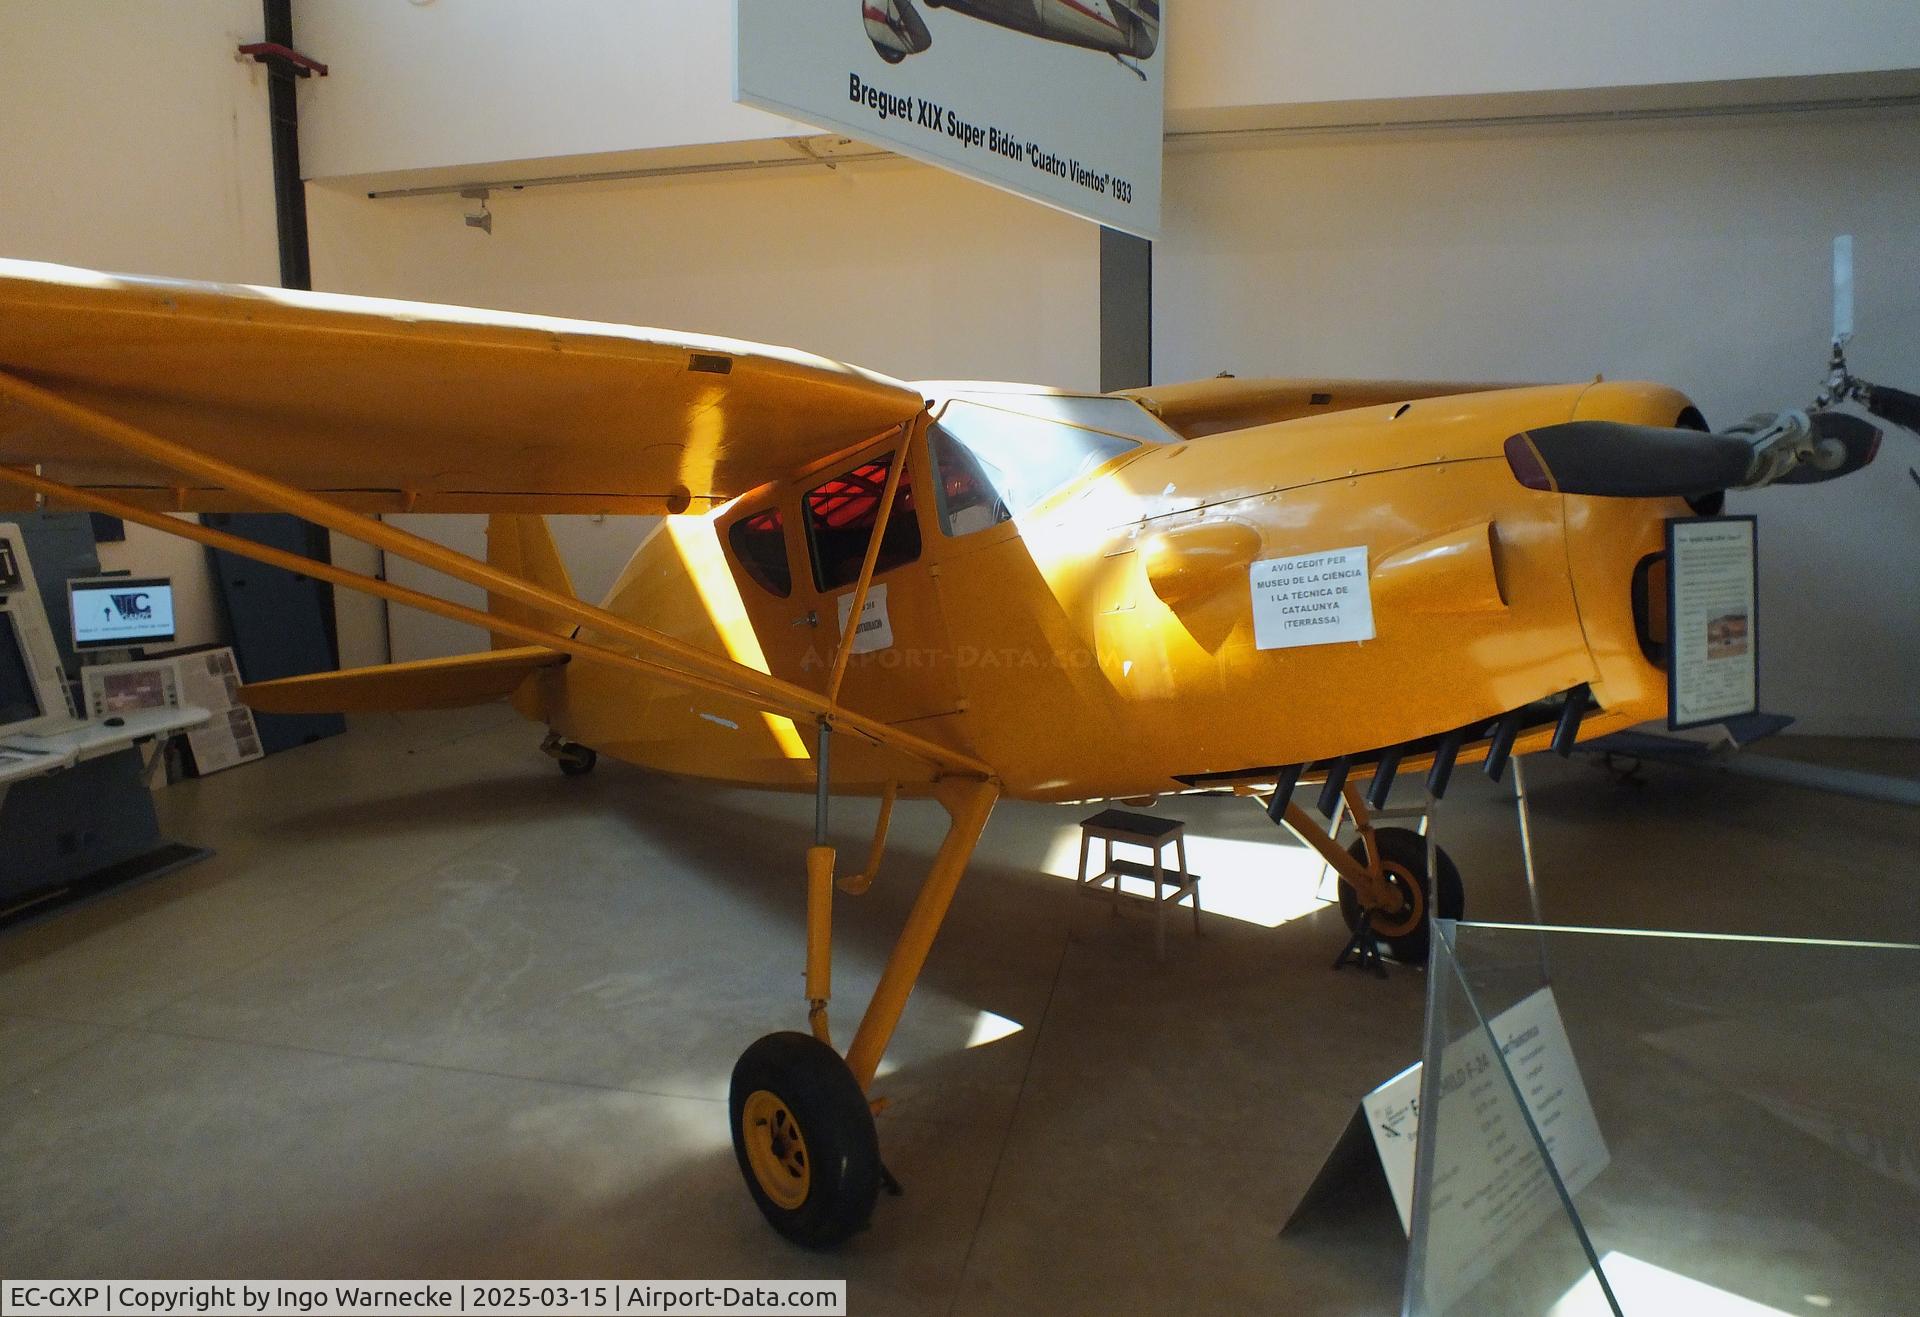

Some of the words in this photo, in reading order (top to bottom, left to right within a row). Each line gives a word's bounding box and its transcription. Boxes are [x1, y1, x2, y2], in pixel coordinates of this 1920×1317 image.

[849, 73, 912, 121] Breguet
[917, 98, 943, 132] XIX
[947, 110, 986, 148] Super
[989, 126, 1022, 162] Bidón
[1112, 176, 1132, 204] 1933
[1297, 558, 1324, 569] CEDIT
[1327, 556, 1346, 566] PER
[1257, 578, 1290, 589] MUSEU
[1292, 576, 1305, 585] DE
[1307, 573, 1320, 583] LA
[1277, 592, 1288, 601] LA
[1335, 586, 1348, 595] DE
[1282, 602, 1339, 614] CATALUNYA
[1284, 616, 1340, 629] (TERRASSA)
